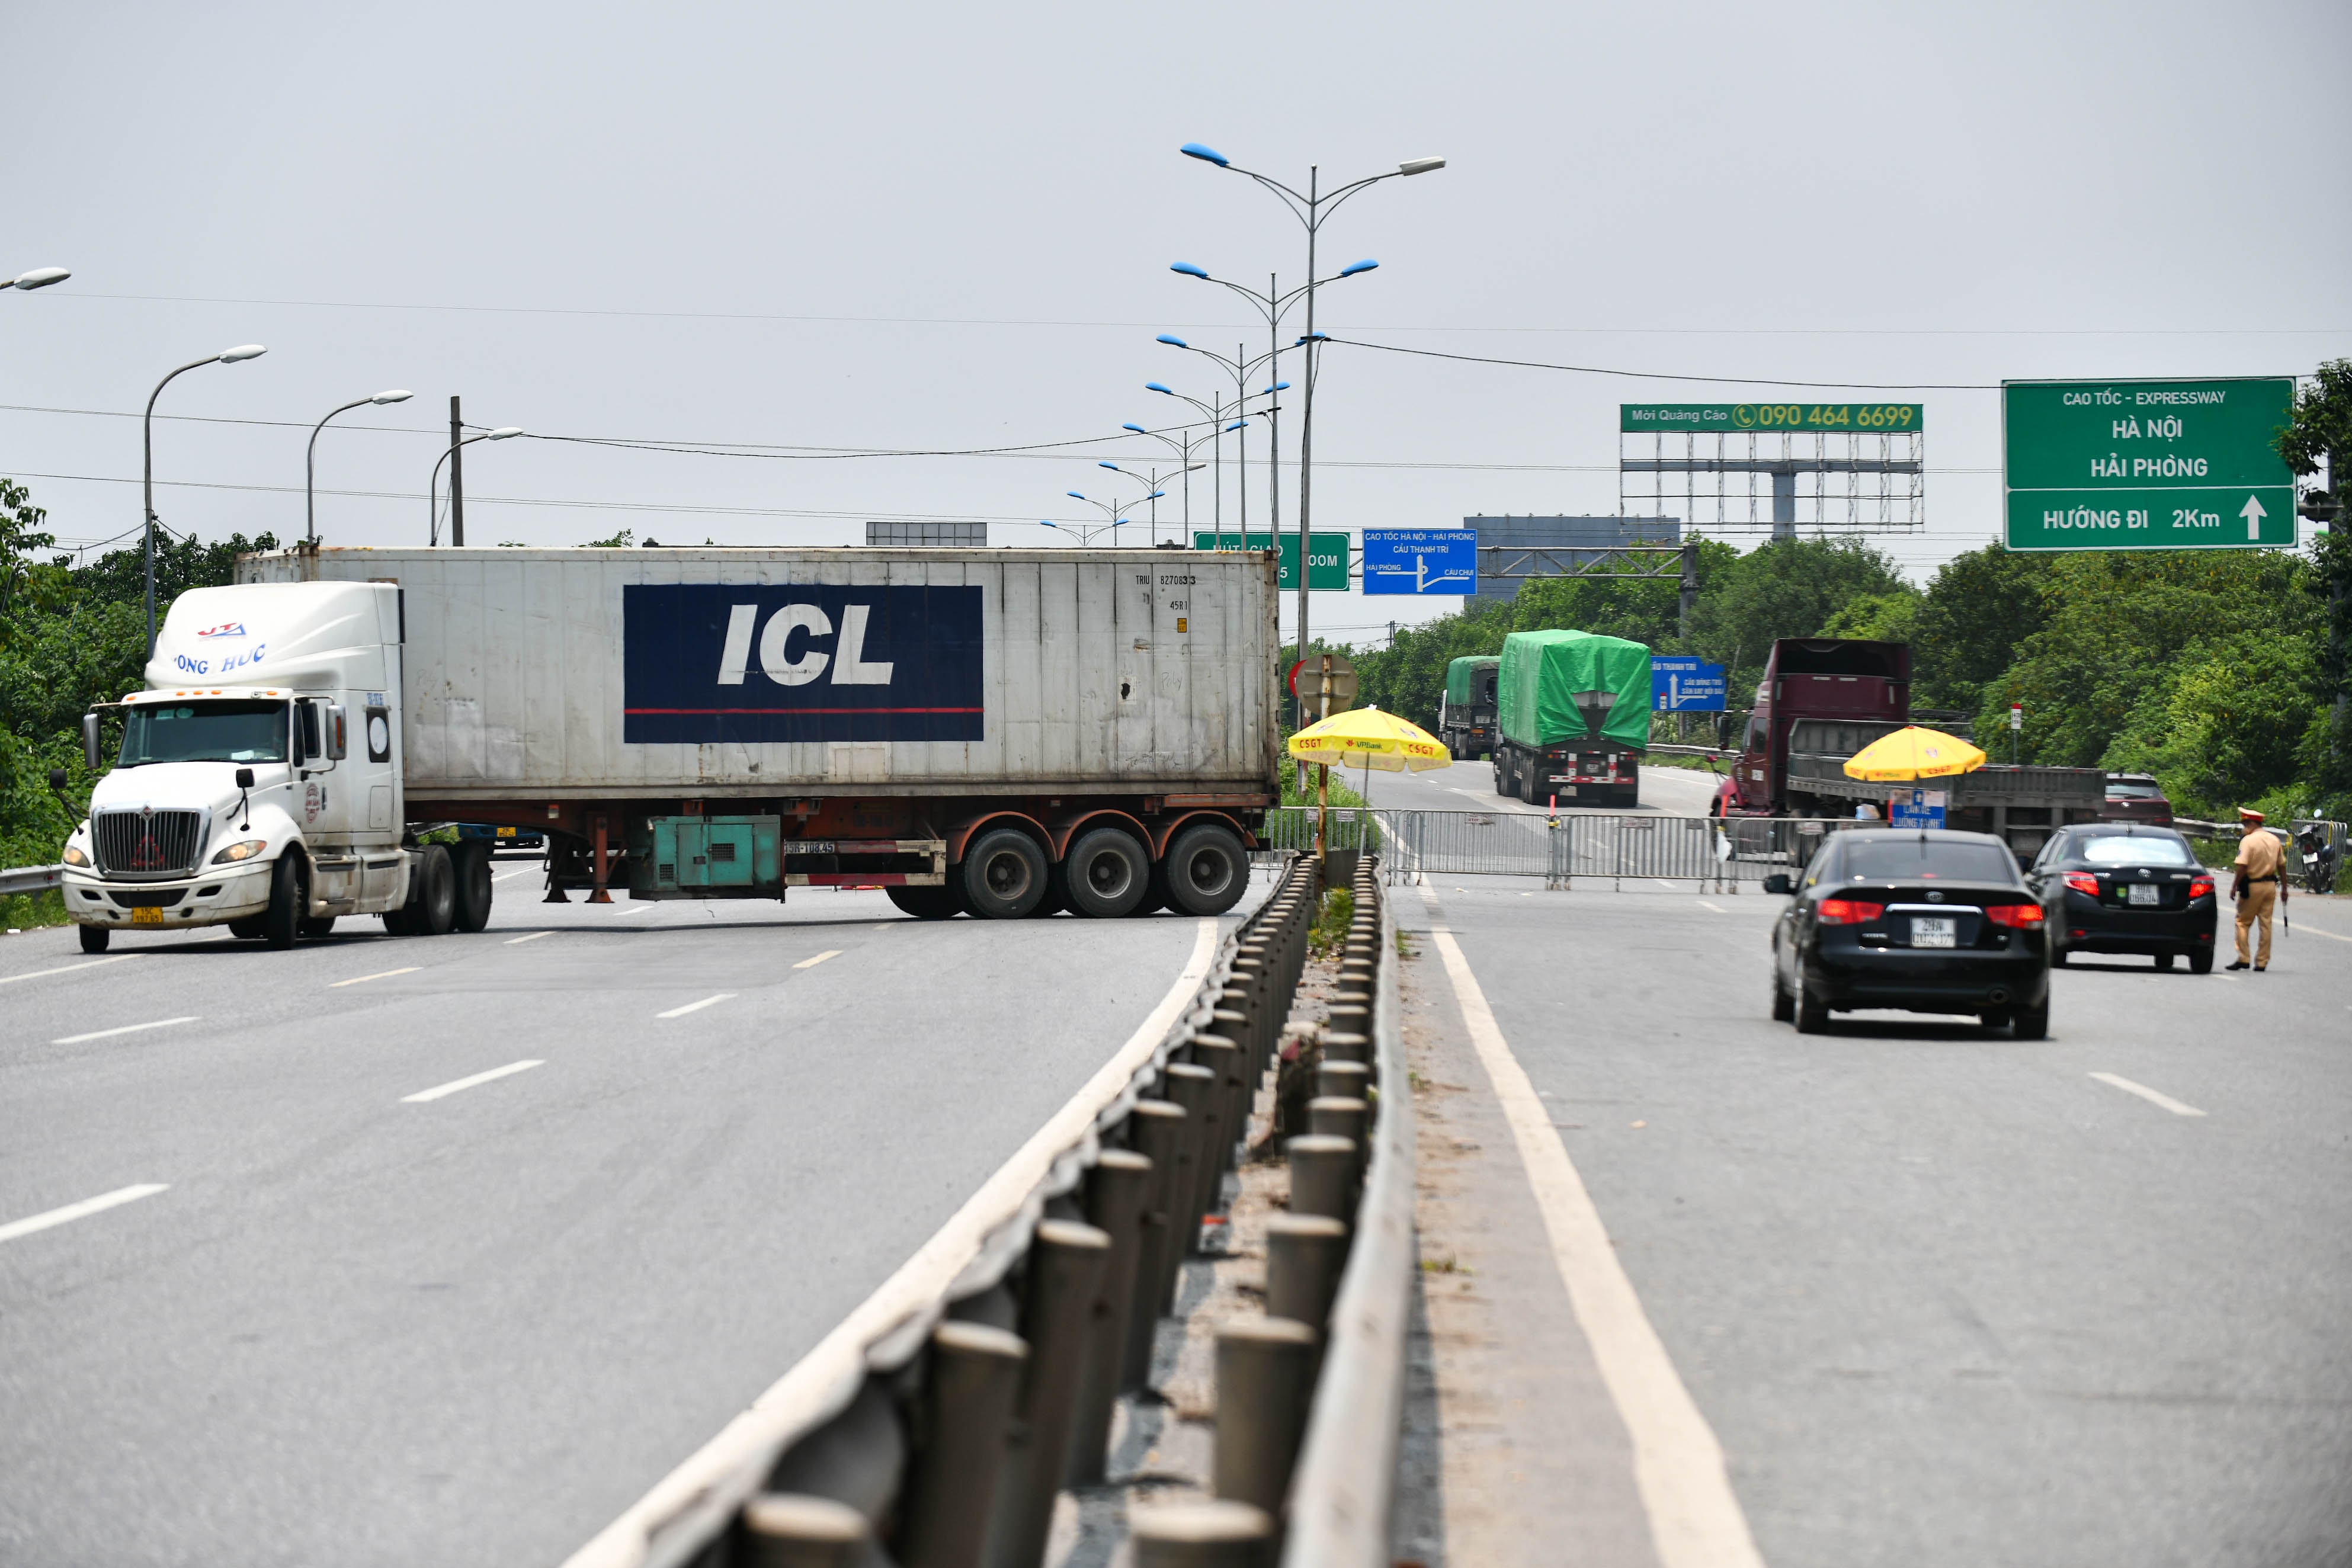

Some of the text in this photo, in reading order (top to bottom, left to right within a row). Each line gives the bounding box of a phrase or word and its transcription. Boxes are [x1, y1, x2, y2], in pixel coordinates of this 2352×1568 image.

[2063, 392, 2092, 405] CAO
[2094, 387, 2122, 405] TỐC
[2136, 391, 2226, 405] EXPRESSWAY
[1703, 409, 1728, 420] Cáo
[1759, 405, 1802, 425] 090
[1808, 406, 1850, 425] 464
[1857, 406, 1913, 426] 6699
[2112, 415, 2183, 442] HÀ NỘI
[2091, 452, 2208, 477] HẢI PHÒNG
[2043, 505, 2220, 529] HƯỚNG ĐI 2Km
[1308, 554, 1337, 566] 00M
[1136, 575, 1150, 585] TRIU
[1170, 601, 1188, 610] 45R1
[717, 603, 894, 686] ICL
[1299, 739, 1435, 755] CSGT VPBank CSGT
